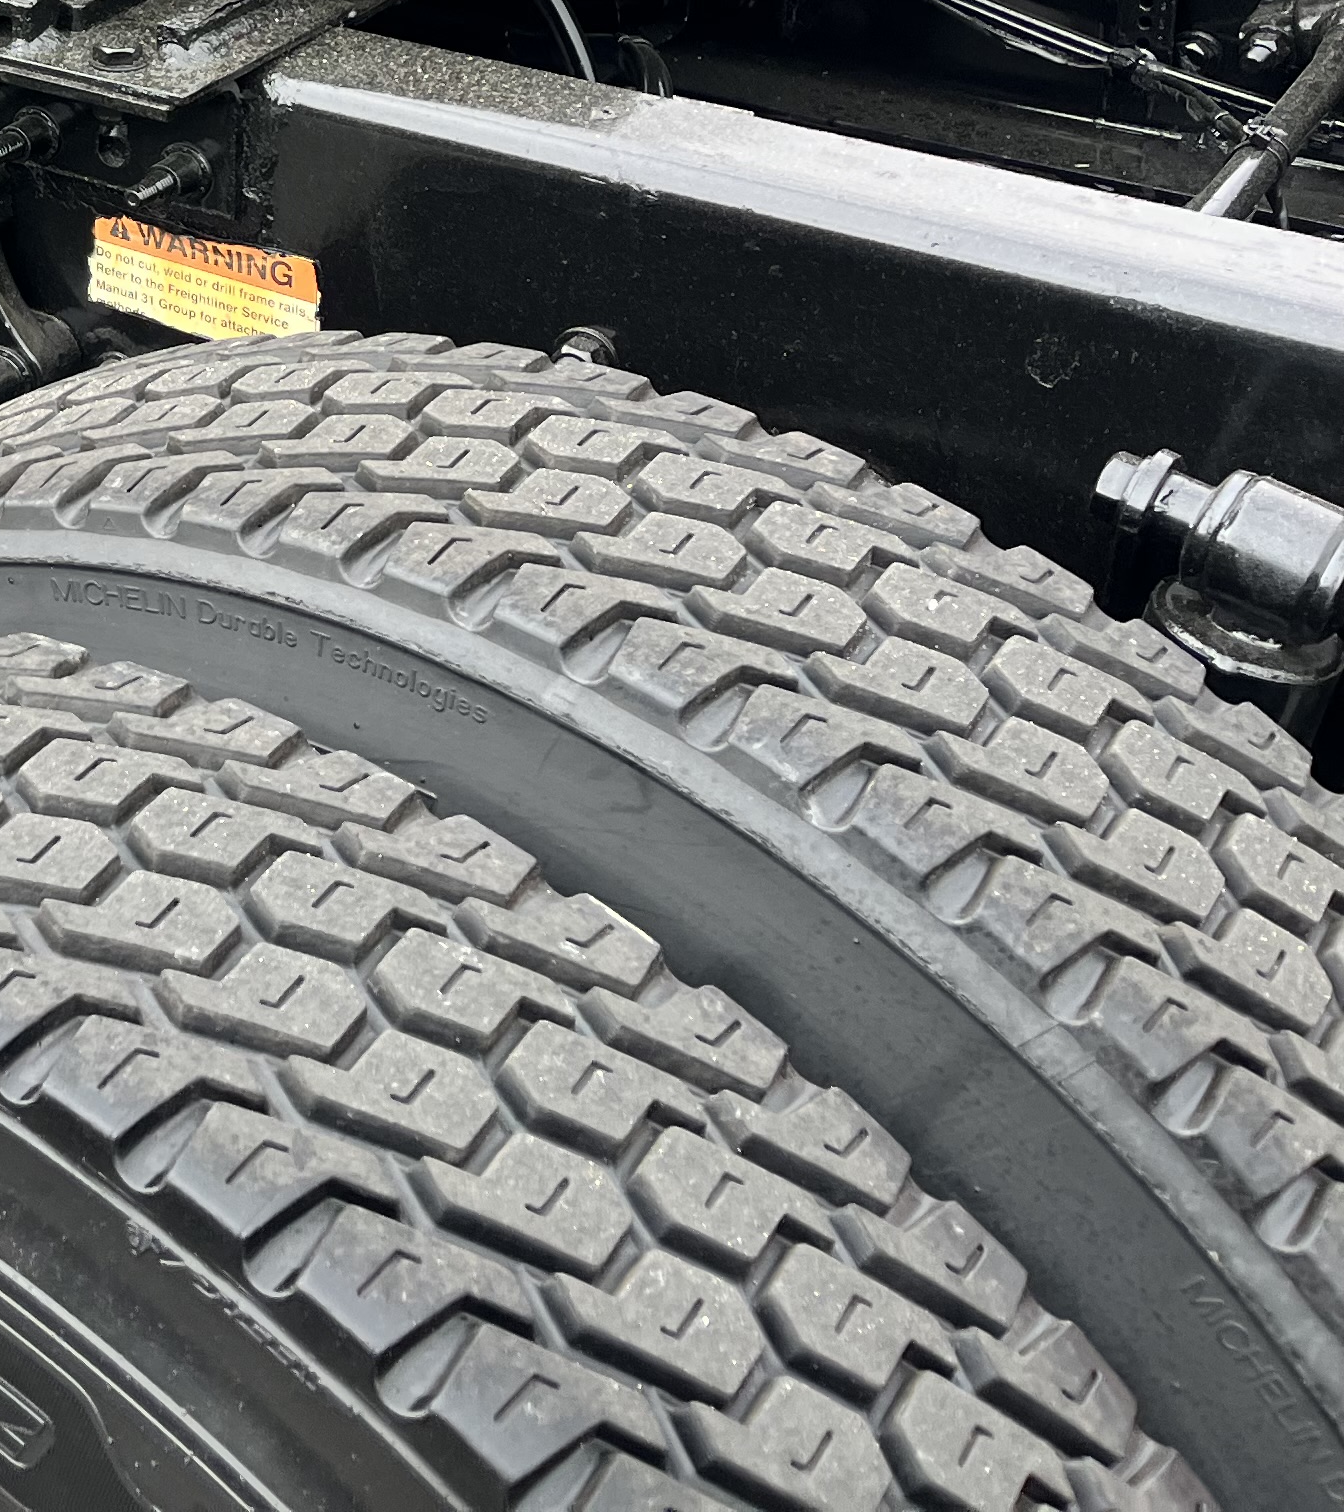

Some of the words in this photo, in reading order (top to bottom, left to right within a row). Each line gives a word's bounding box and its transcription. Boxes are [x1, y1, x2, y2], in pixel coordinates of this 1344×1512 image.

[96, 245, 111, 260] Do
[116, 250, 134, 267] not
[139, 258, 160, 275] cut,
[164, 266, 192, 284] weld
[195, 275, 208, 287] or
[212, 278, 235, 297] drill
[239, 286, 275, 308] frame
[136, 221, 294, 289] WARNING
[96, 262, 129, 281] Refer
[130, 269, 142, 285] to
[145, 275, 165, 292] the
[168, 284, 238, 315] Freightliner
[241, 305, 289, 330] Service
[96, 279, 138, 300] Manual
[141, 292, 155, 306] 31
[159, 298, 196, 320] Group
[200, 310, 217, 325] for
[49, 576, 187, 620] MICHELIN
[196, 598, 299, 650] Durable
[311, 630, 489, 726] Technologies
[1179, 1273, 1338, 1463] MICHELIN
